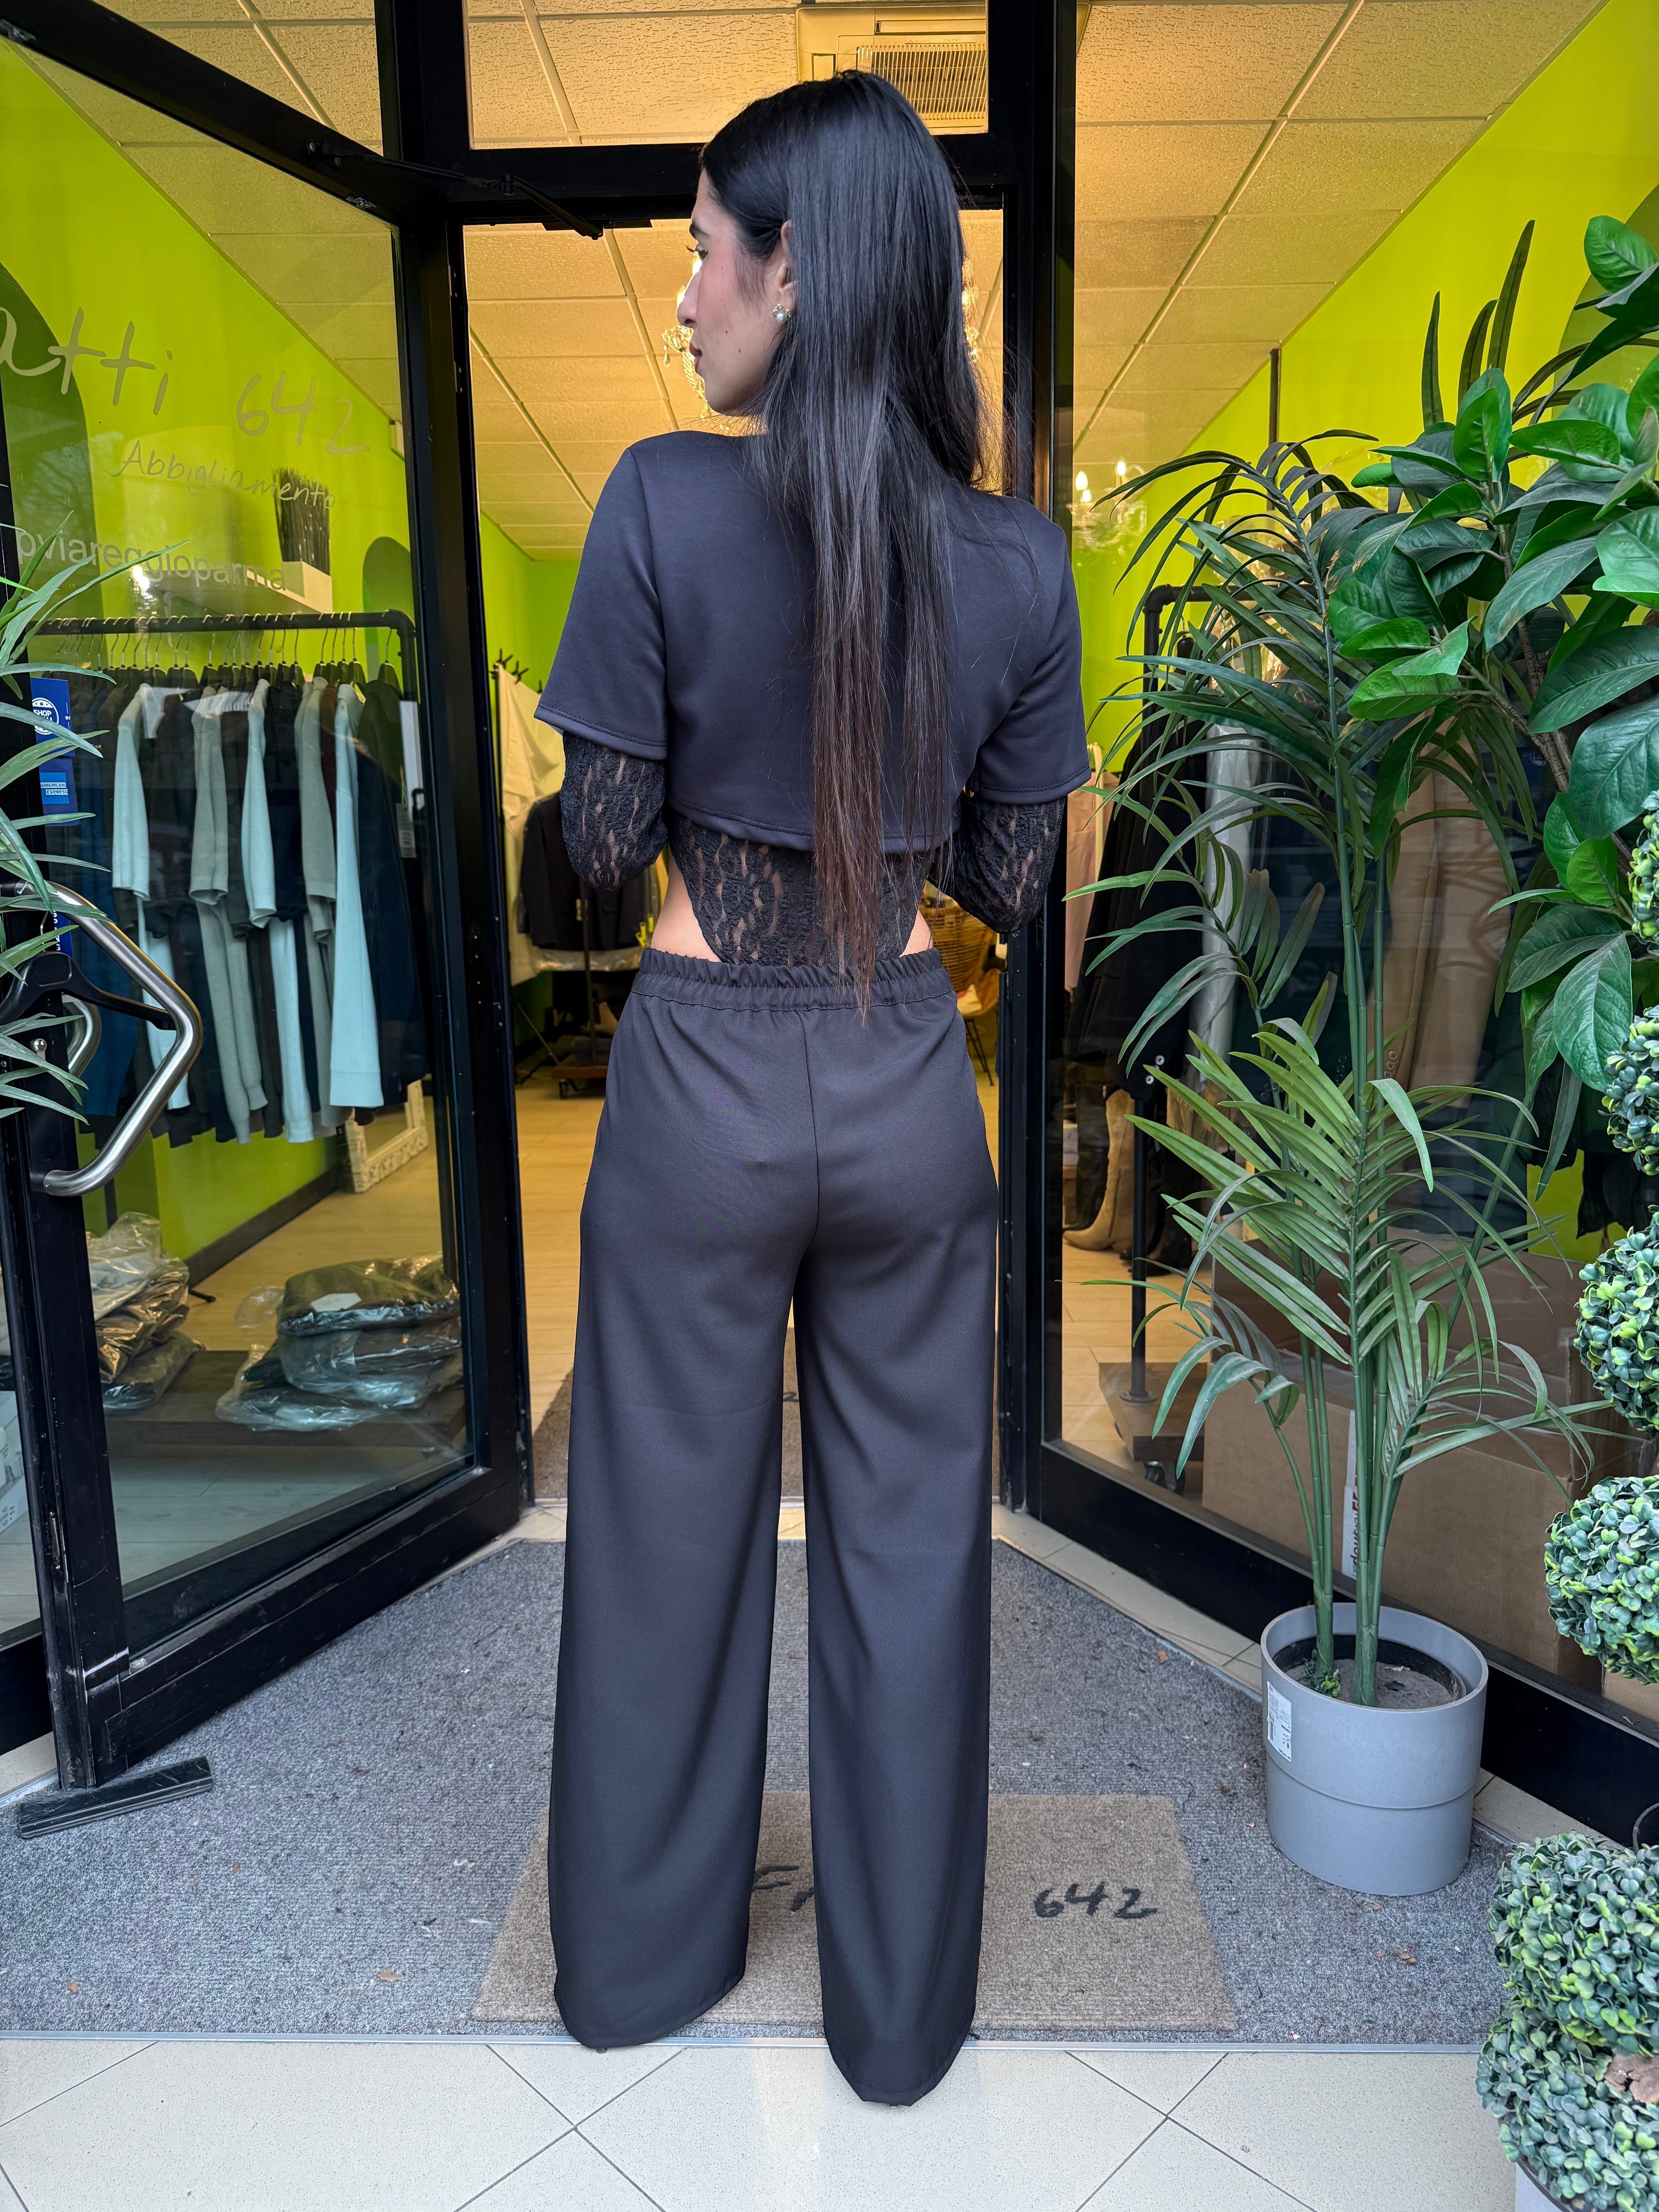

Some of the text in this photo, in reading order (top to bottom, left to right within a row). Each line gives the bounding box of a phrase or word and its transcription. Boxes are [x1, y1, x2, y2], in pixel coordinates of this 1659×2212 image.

[237, 371, 370, 455] 642
[111, 440, 335, 509] Abbigliamento
[1034, 1881, 1158, 1918] 642
